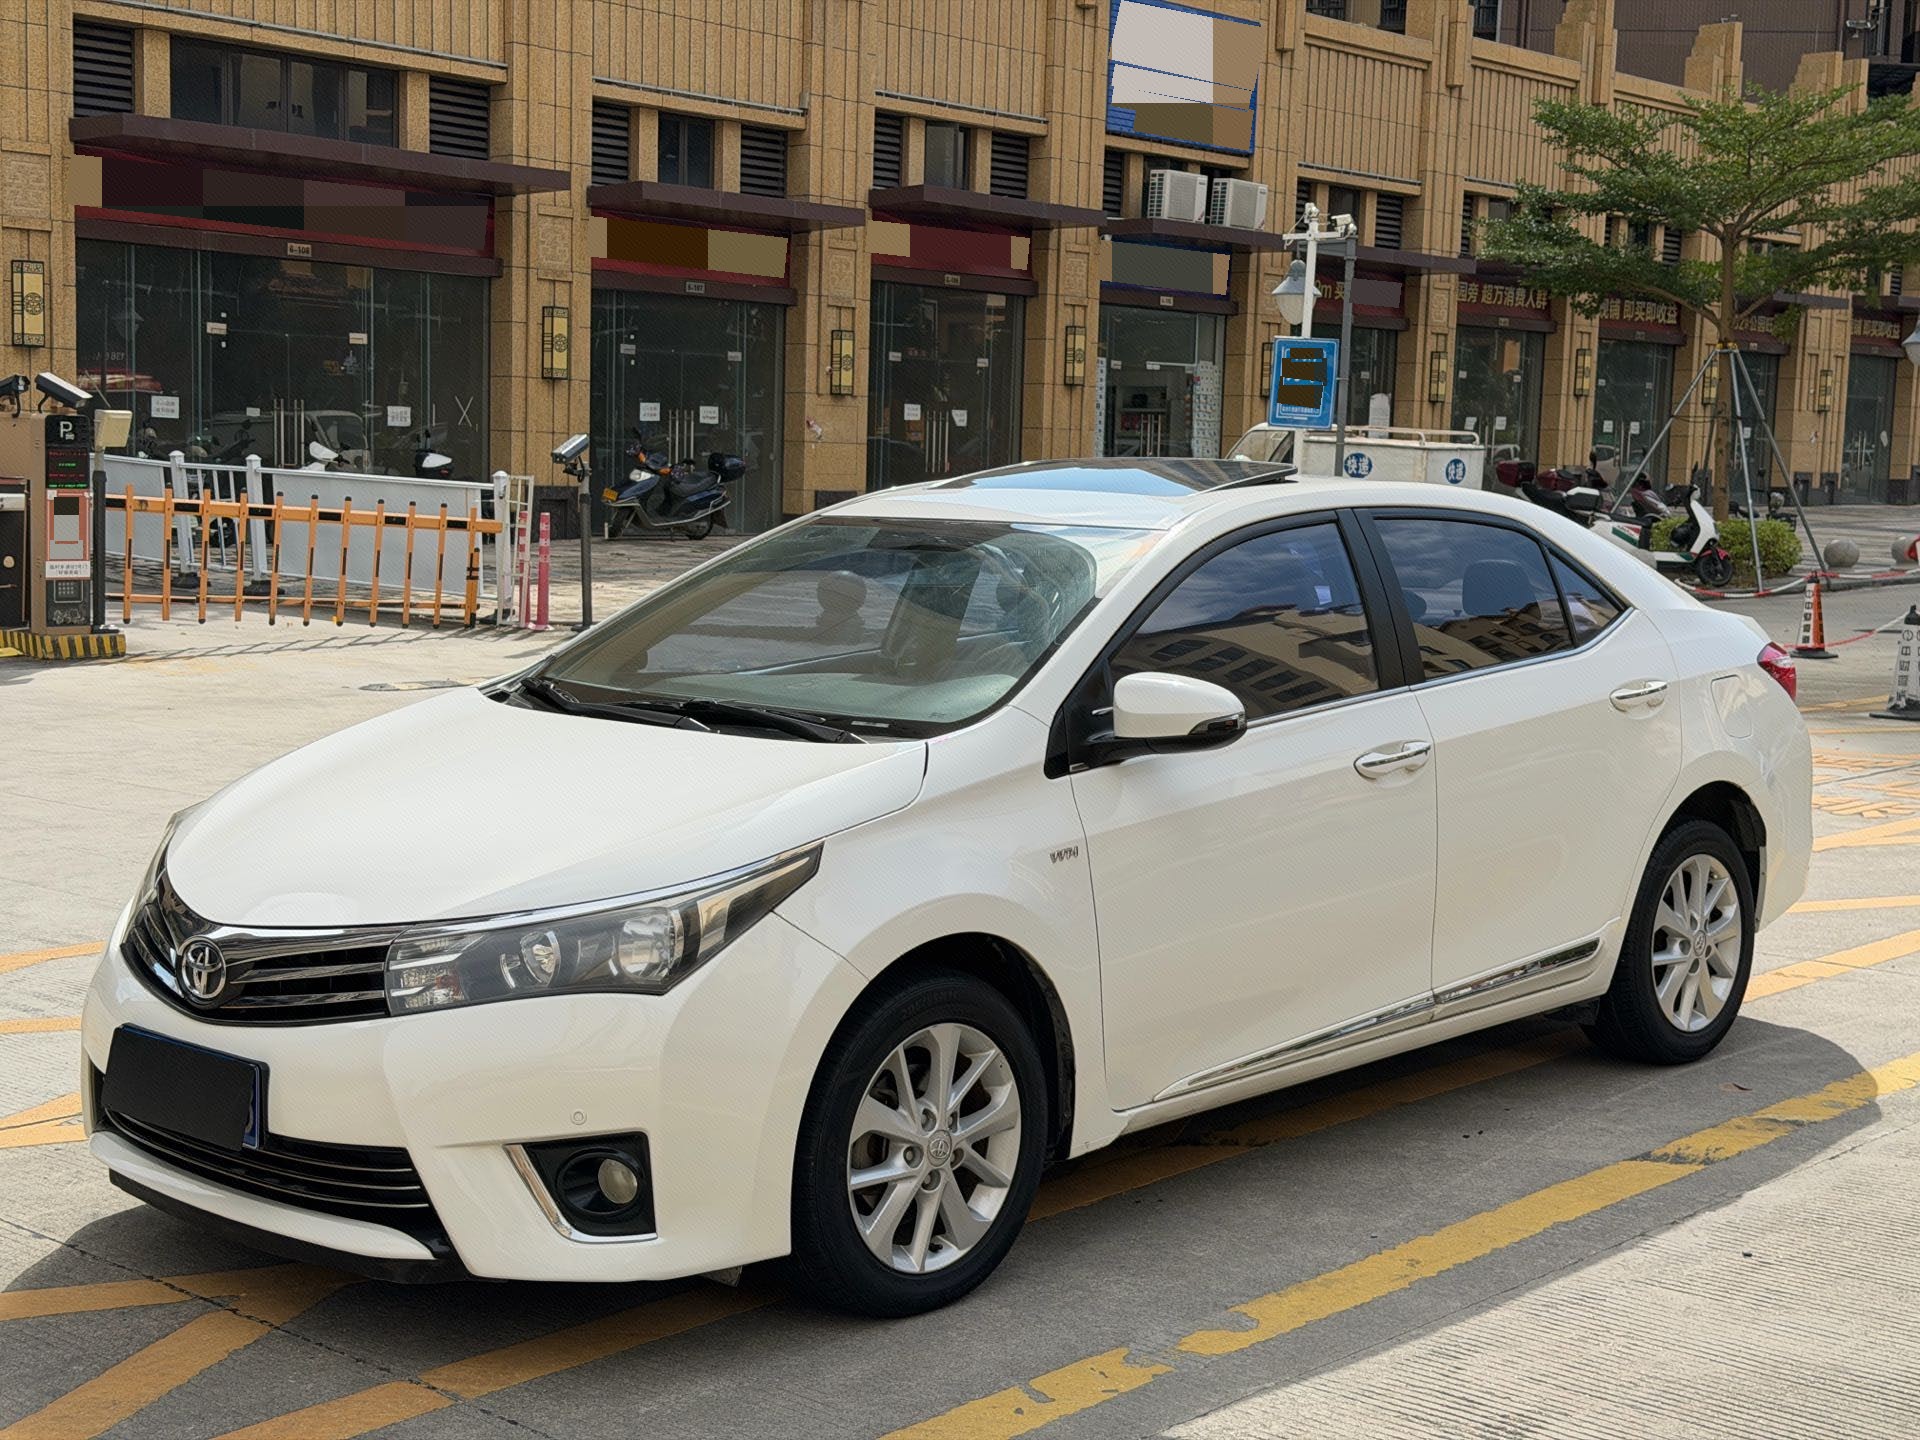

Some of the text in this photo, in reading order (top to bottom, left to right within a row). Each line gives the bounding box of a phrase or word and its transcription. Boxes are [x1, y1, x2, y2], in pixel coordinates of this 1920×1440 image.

[1481, 282, 1548, 310] 超万消费人群
[1623, 299, 1678, 325] 即买即收益
